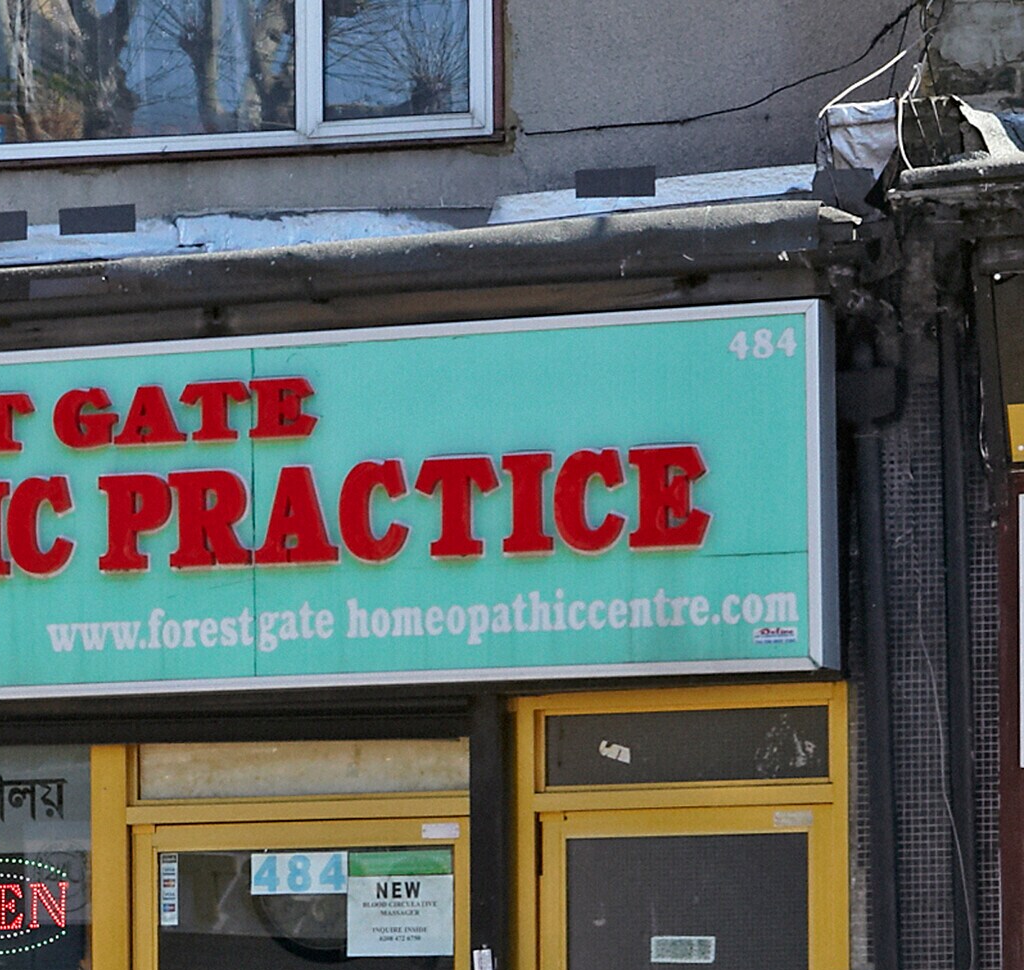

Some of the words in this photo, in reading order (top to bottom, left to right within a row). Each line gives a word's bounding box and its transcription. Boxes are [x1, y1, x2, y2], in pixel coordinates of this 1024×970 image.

[728, 326, 797, 361] 484
[51, 375, 320, 452] GATE
[96, 442, 714, 575] PRACTICE
[346, 588, 799, 647] homeopathiccentre.com
[254, 853, 347, 892] 484
[376, 881, 421, 899] NEW
